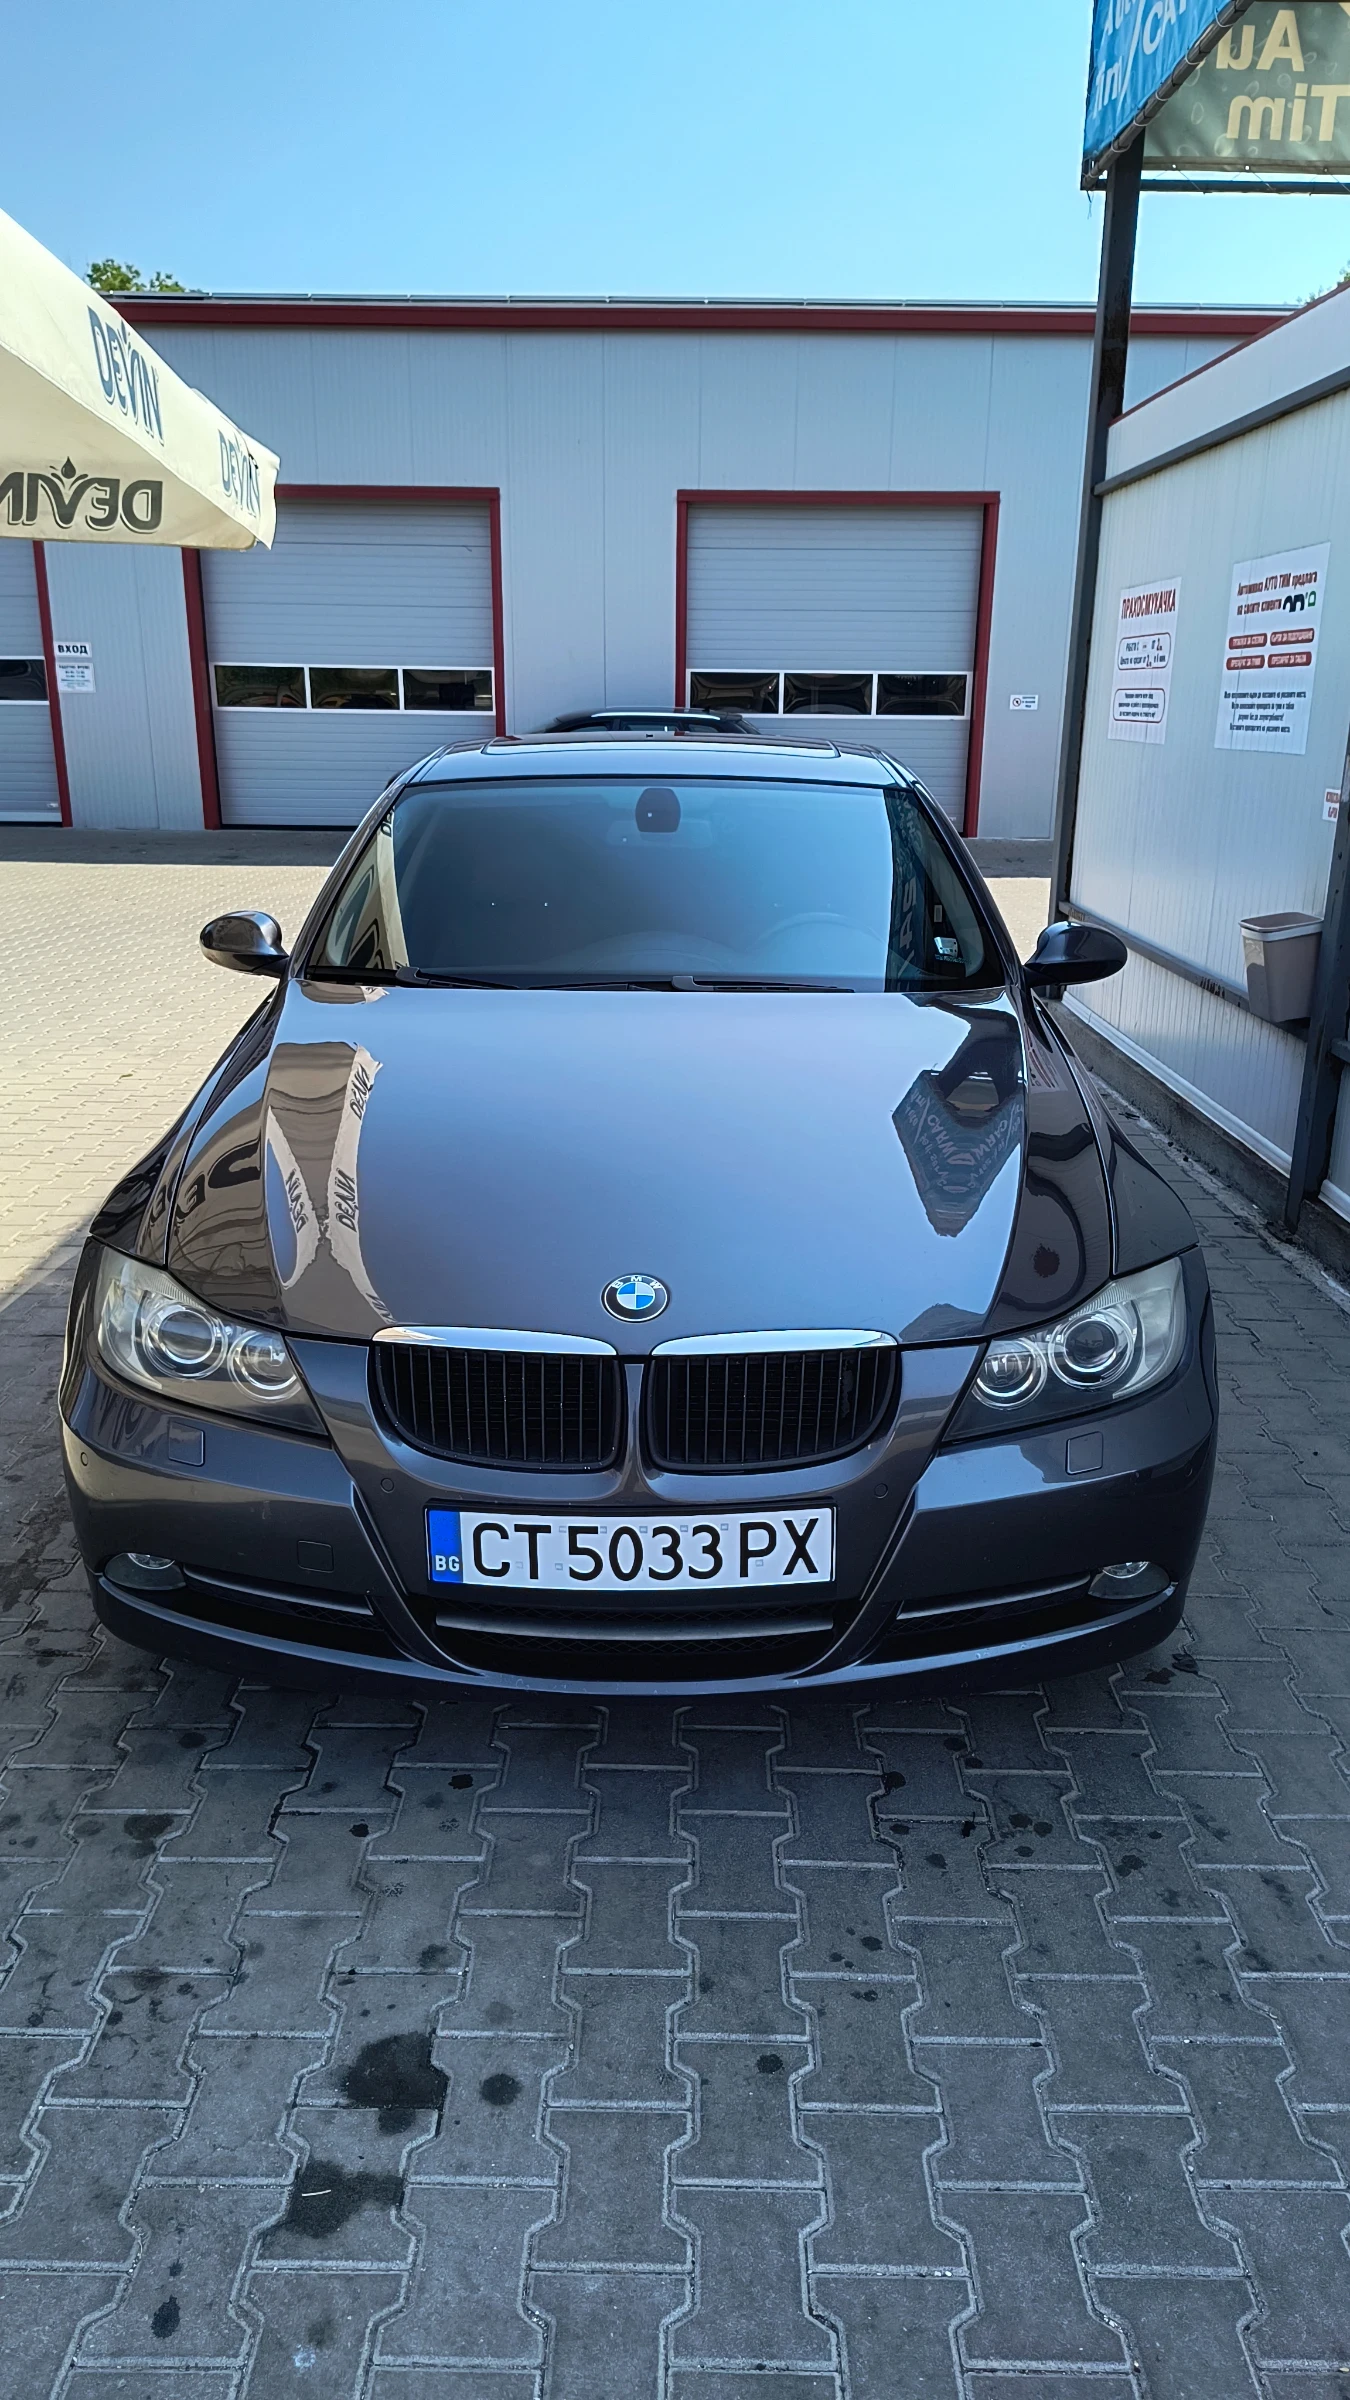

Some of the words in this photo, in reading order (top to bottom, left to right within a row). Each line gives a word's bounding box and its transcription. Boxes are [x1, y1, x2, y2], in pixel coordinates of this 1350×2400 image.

[87, 305, 164, 447] DEVIN
[218, 429, 262, 519] DEVIN
[58, 645, 88, 655] ВХОД
[610, 1275, 663, 1290] BMW
[435, 1555, 461, 1571] BG
[472, 1522, 552, 1580] CT
[568, 1525, 723, 1582] 5033
[739, 1518, 820, 1578] PX
